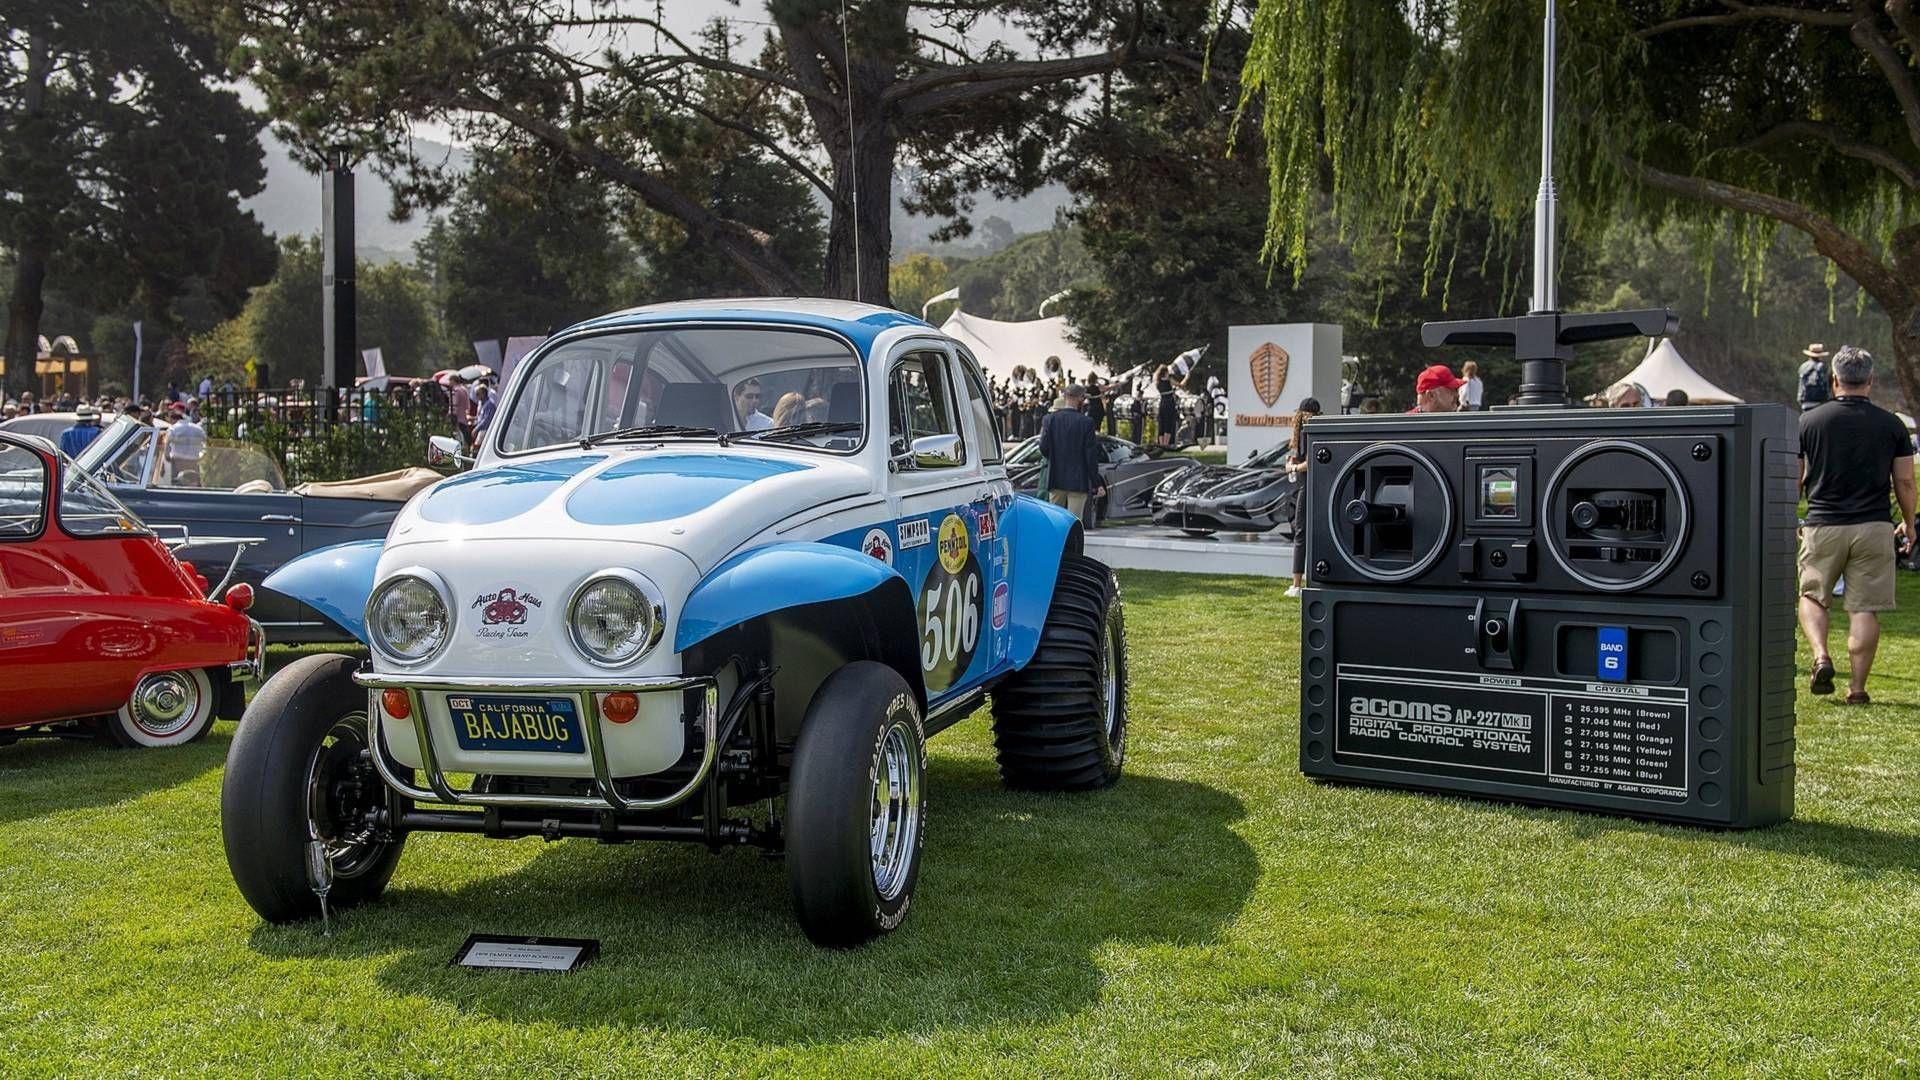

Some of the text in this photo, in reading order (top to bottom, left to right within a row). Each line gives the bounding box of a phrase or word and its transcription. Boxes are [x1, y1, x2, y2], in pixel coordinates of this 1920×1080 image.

[899, 520, 928, 540] SIMPSON
[472, 593, 542, 609] Auto Haus
[922, 572, 978, 672] 506
[476, 627, 528, 639] Racing Team
[1600, 643, 1623, 652] BAND
[1604, 656, 1618, 669] 6
[1483, 678, 1517, 686] POWER
[1594, 685, 1641, 695] CRYSTAL
[452, 700, 470, 708] OCT
[479, 704, 545, 713] CALIFORNIA
[886, 692, 905, 721] TIRES
[1350, 697, 1452, 722] acoms
[1565, 703, 1572, 711] 1
[1613, 708, 1631, 716] MHz
[1636, 709, 1671, 719] (Brown)
[463, 712, 569, 741] BAJABUG
[1349, 717, 1532, 744] DIGITAL PROPORTIONAL
[1564, 715, 1661, 731] 2 27.045 MHz (Red)
[1349, 726, 1531, 753] RADIO CONTROL SYSTEM
[1564, 727, 1573, 735] 3
[1613, 732, 1631, 740] MHz
[1636, 734, 1673, 744] (Orange)
[1564, 739, 1573, 747] 4
[1613, 744, 1631, 752] MHz
[1636, 745, 1672, 756] (Yellow)
[1564, 751, 1573, 759] 5
[1613, 756, 1631, 765] MHz
[1636, 758, 1668, 768] (Green)
[1564, 762, 1573, 770] 6
[1613, 768, 1631, 777] MHz
[1636, 769, 1663, 780] (Blue)
[1549, 776, 1600, 788] MANUFACTURED
[1617, 784, 1639, 792] ASAHI
[1641, 786, 1688, 798] CORPORATION
